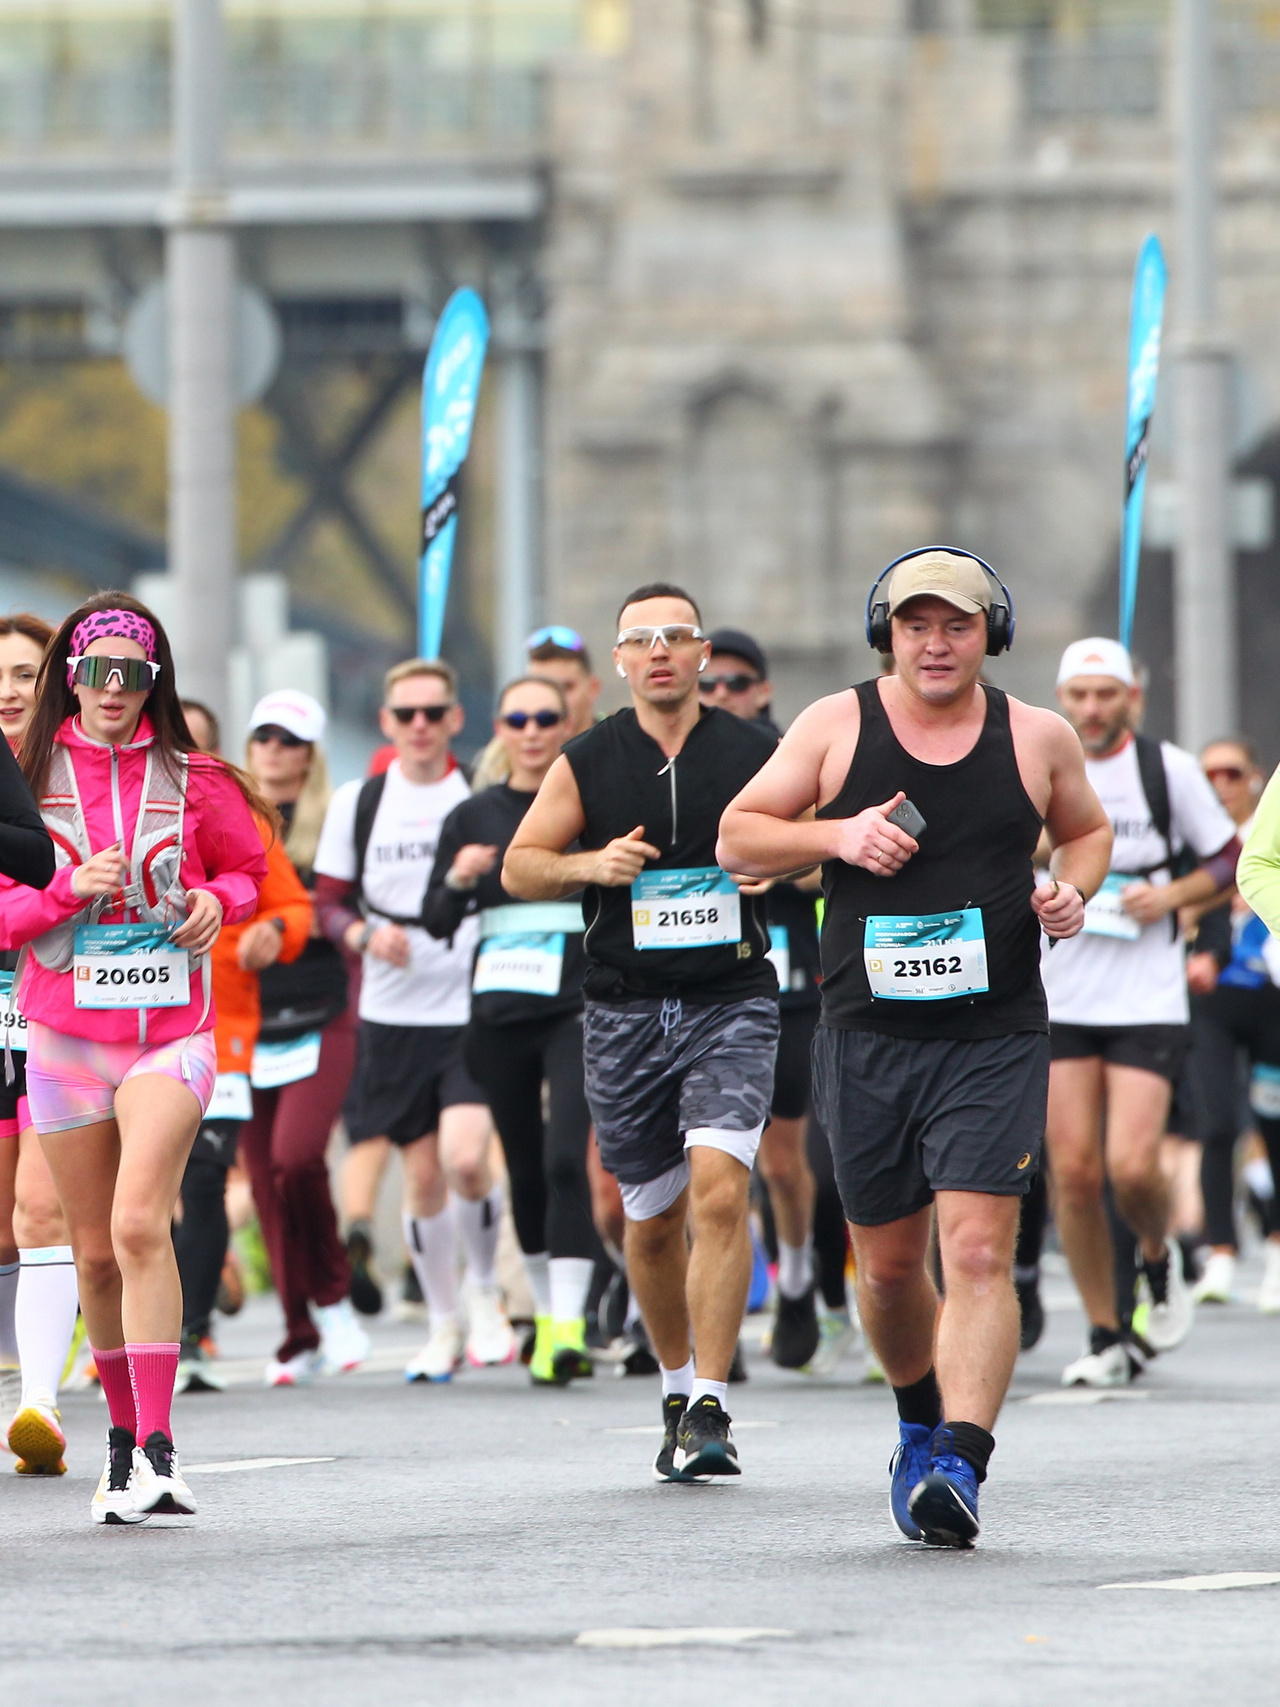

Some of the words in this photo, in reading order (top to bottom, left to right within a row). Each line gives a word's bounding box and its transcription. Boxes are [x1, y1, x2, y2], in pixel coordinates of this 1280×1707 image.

[657, 907, 719, 927] 21658
[95, 965, 170, 985] 20605
[870, 960, 881, 971] D
[893, 956, 963, 977] 23162
